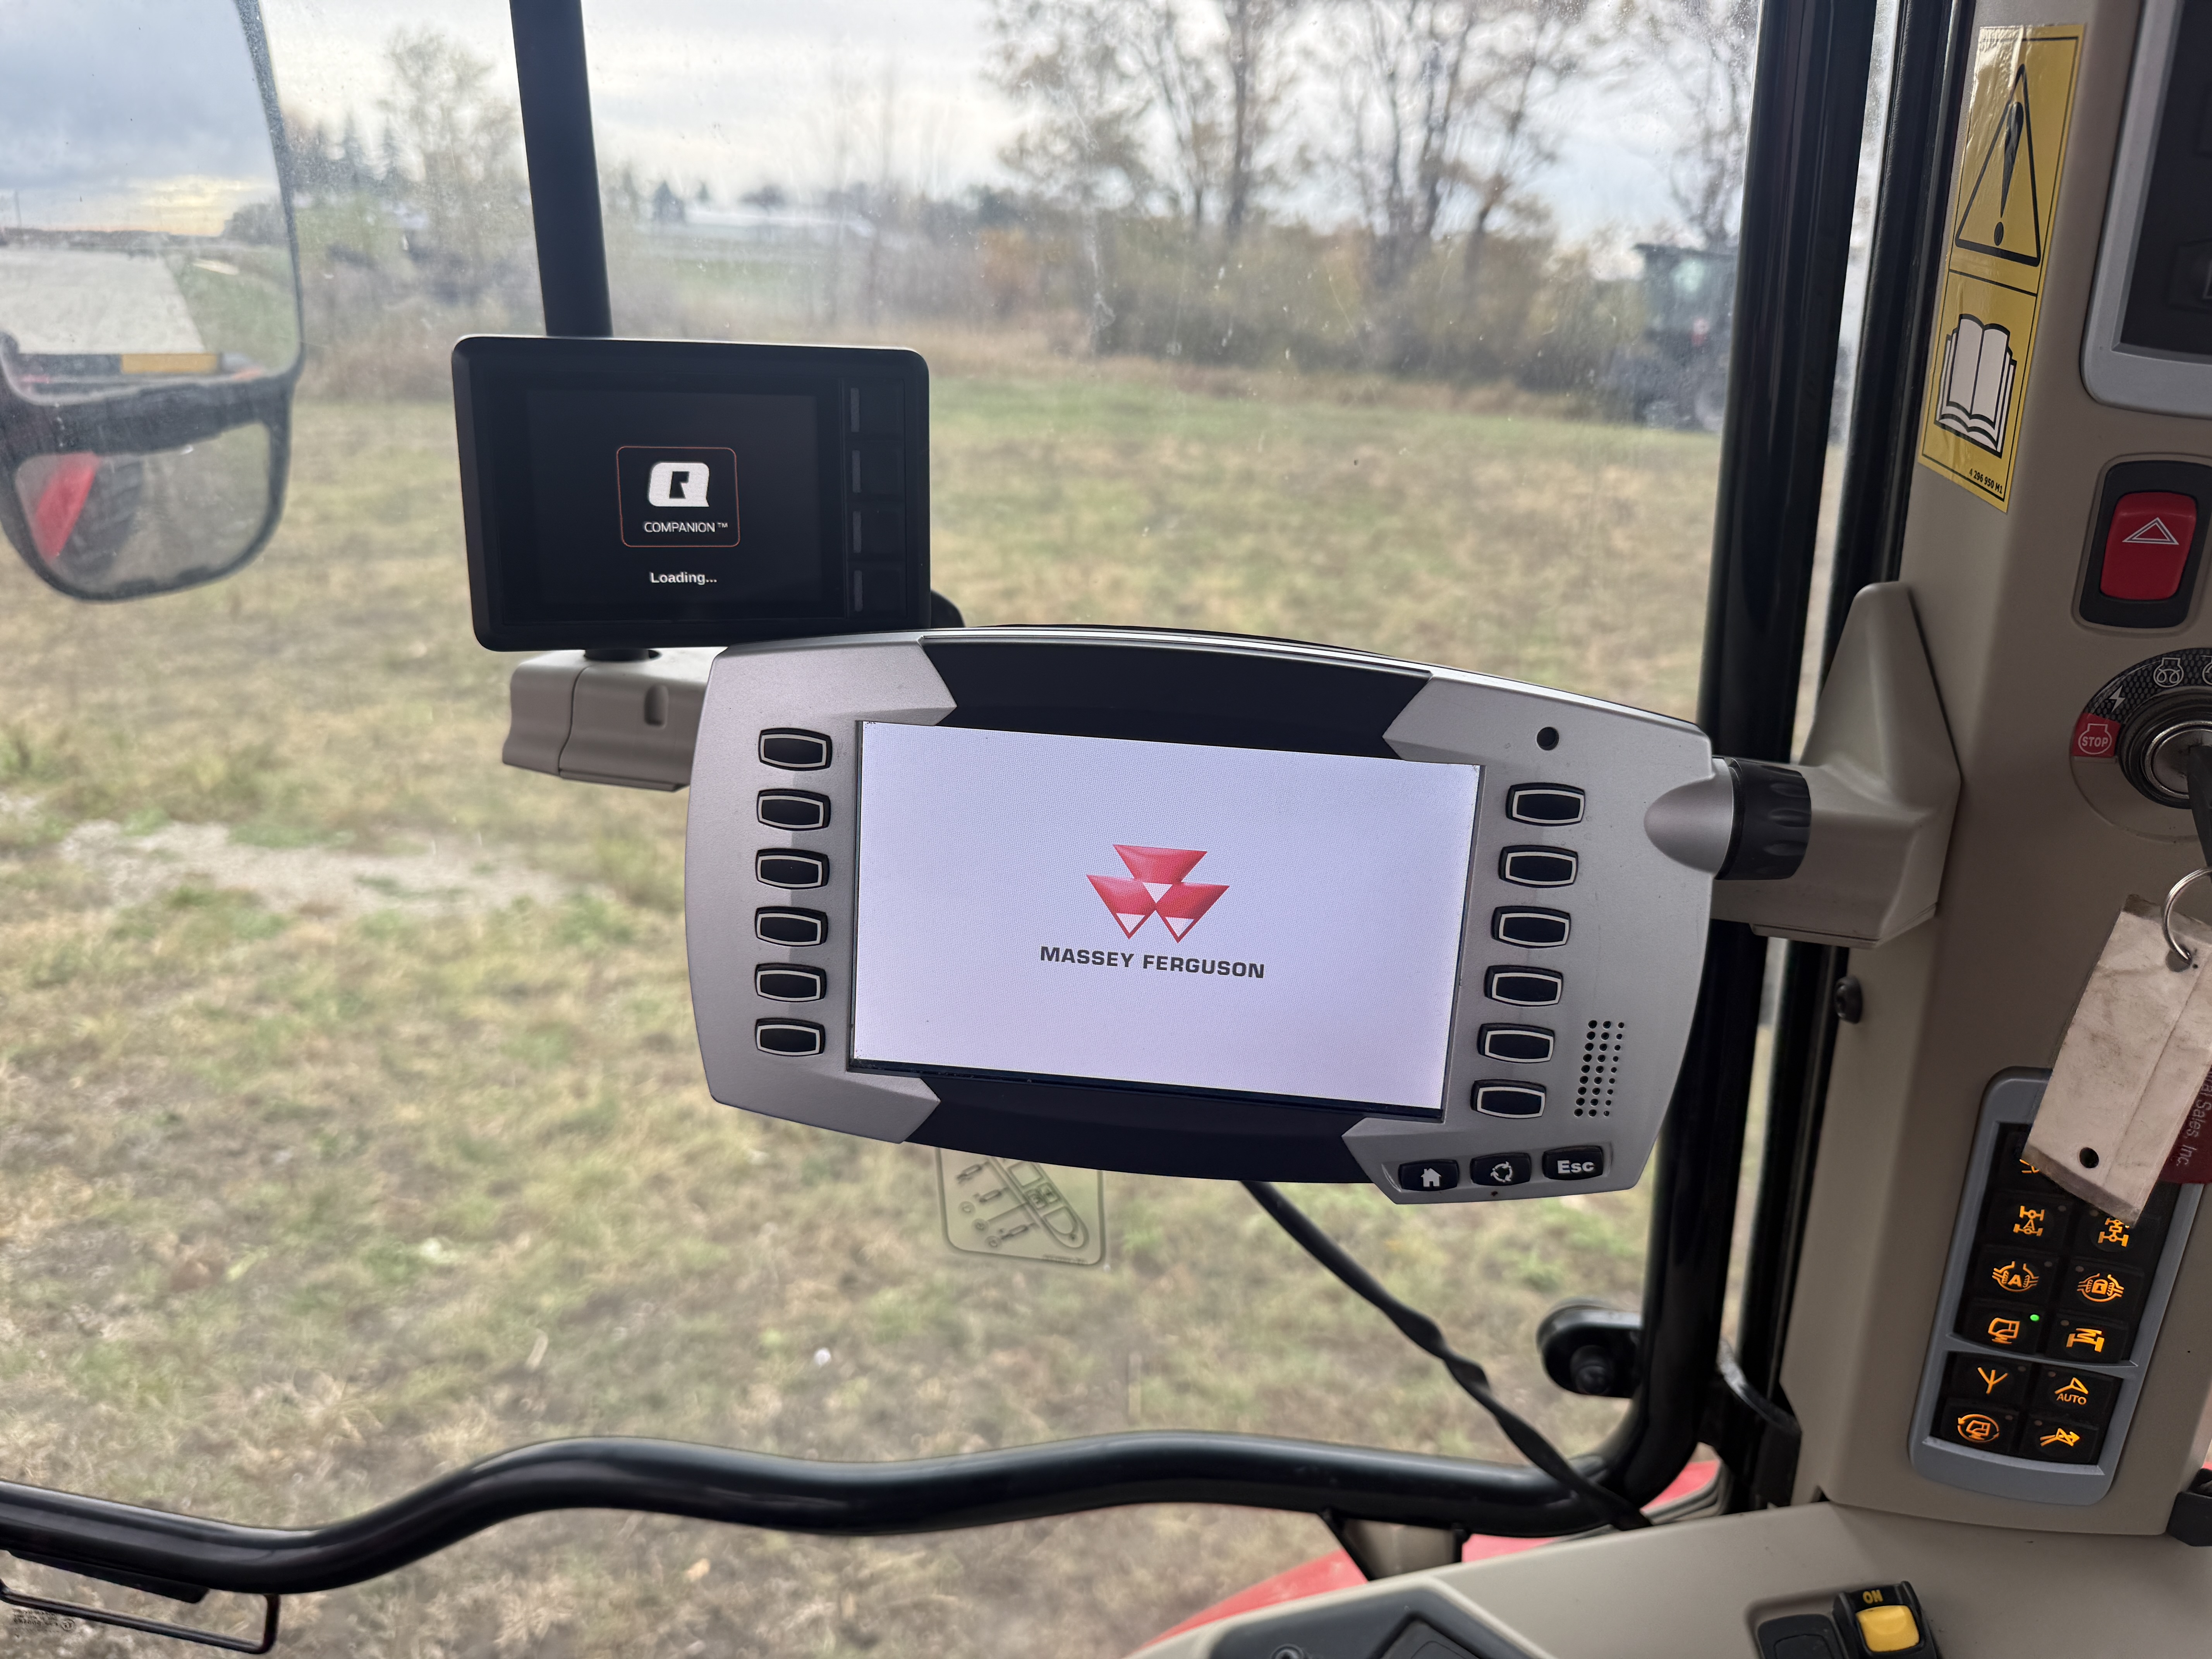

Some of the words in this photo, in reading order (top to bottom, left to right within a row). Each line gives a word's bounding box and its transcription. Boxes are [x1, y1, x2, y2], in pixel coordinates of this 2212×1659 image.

[1969, 468, 1973, 477] 4
[1973, 470, 1984, 483] 296
[1984, 476, 1994, 489] 950
[1995, 482, 2002, 494] M1
[644, 522, 716, 533] COMPANION
[650, 572, 717, 586] Loading...
[2081, 736, 2109, 747] STOP
[1040, 946, 1135, 968] MASSEY
[1143, 954, 1265, 979] FERGUSON
[2176, 1144, 2197, 1166] Inc.
[1557, 1160, 1595, 1174] Esc
[2056, 1393, 2087, 1405] AUTO
[1862, 1589, 1884, 1604] ON
